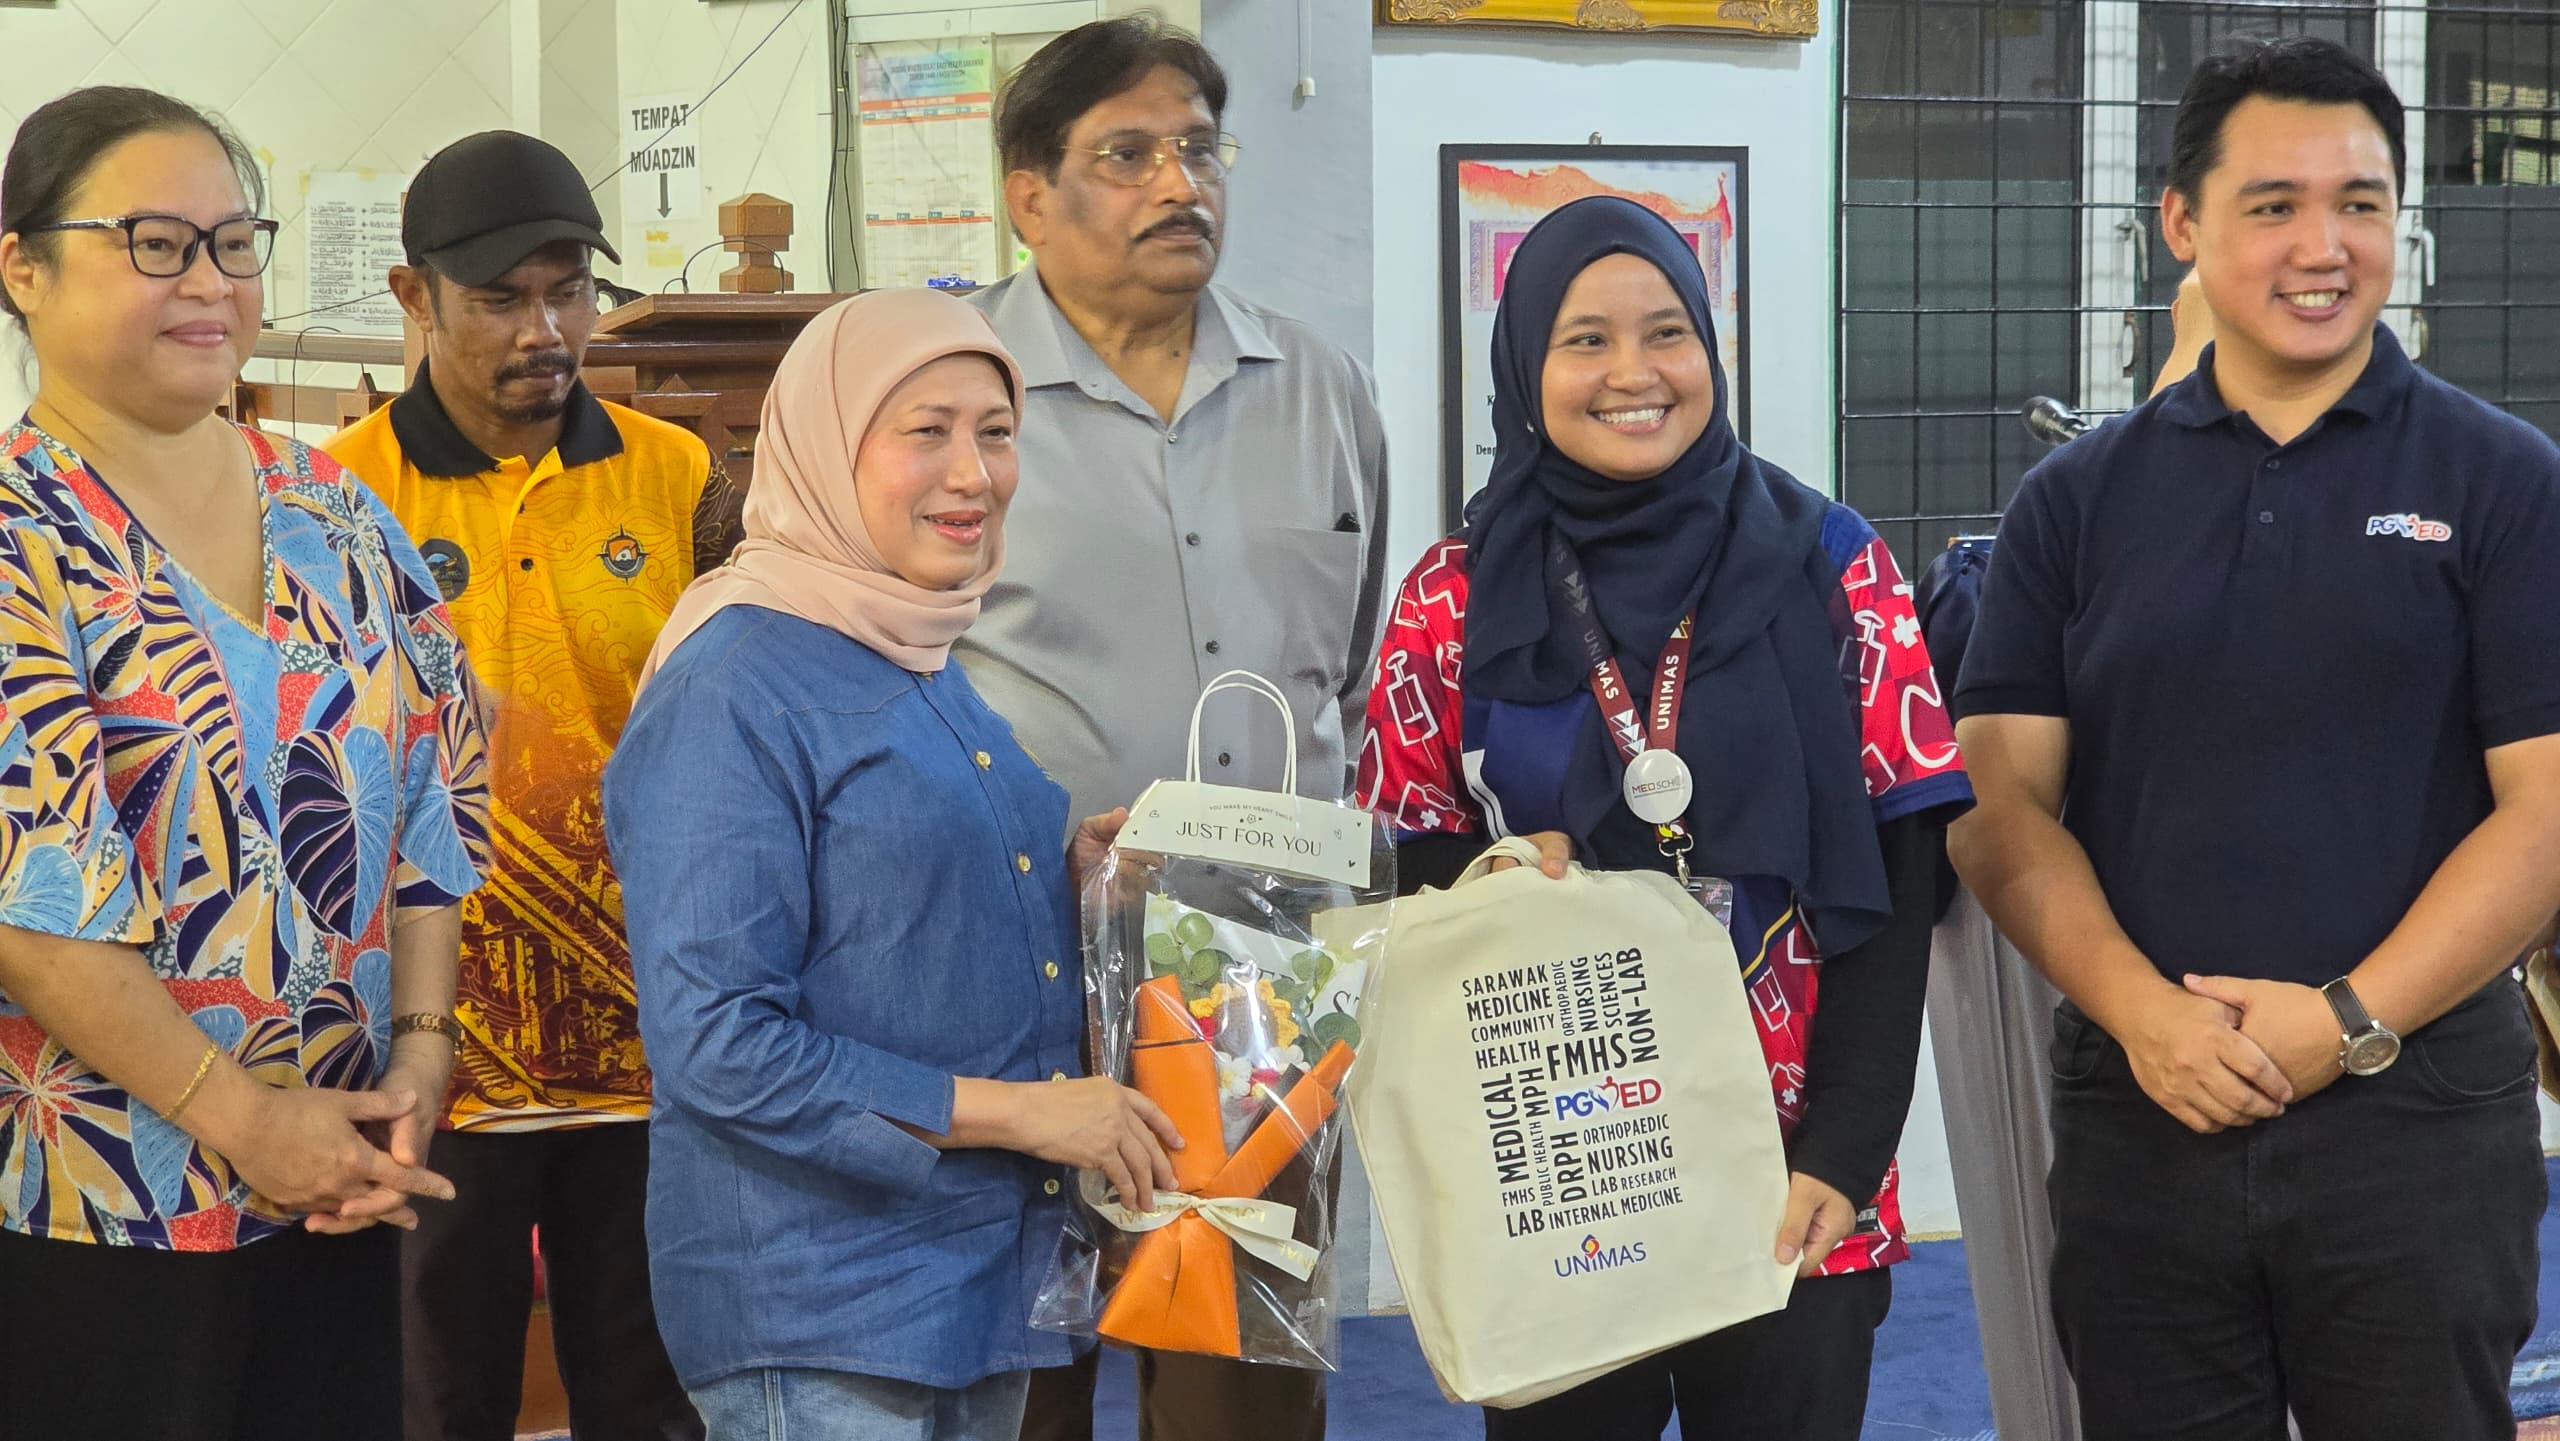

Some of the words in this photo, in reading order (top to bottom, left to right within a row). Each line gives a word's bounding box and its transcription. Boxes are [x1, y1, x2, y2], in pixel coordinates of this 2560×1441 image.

[632, 104, 689, 131] TEMPAT
[630, 145, 696, 173] MUADZIN
[1656, 654, 1680, 730] UNIMAS
[1176, 821, 1228, 841] JUST
[1234, 827, 1274, 849] FOR
[1282, 834, 1321, 857] YOU
[1462, 964, 1548, 998] SARAWAK
[1551, 960, 1575, 1037] ORTHOPAEDIC
[1570, 956, 1599, 1032] NURSING
[1594, 952, 1623, 1028] SCIENCES
[1466, 987, 1552, 1022] MEDICINE
[1616, 947, 1660, 1064] NON-LAB
[1471, 1013, 1554, 1043] COMMUNITY
[1475, 1039, 1541, 1070] HEALTH
[1545, 1032, 1628, 1082] FMHS
[1517, 1067, 1550, 1118] MPH
[1481, 1072, 1530, 1185] MEDICAL
[1528, 1121, 1548, 1164] HEALTH
[1583, 1113, 1670, 1146] ORTHOPAEDIC
[1550, 1131, 1588, 1203] DRPH
[1587, 1136, 1674, 1175] NURSING
[1502, 1187, 1536, 1207] FMHS
[1537, 1166, 1555, 1207] PUBLIC
[1591, 1176, 1618, 1197] LAB
[1620, 1166, 1677, 1191] RESEARCH
[1506, 1208, 1545, 1238] LAB
[1549, 1200, 1619, 1230] INTERNAL
[1620, 1186, 1683, 1216] MEDICINE
